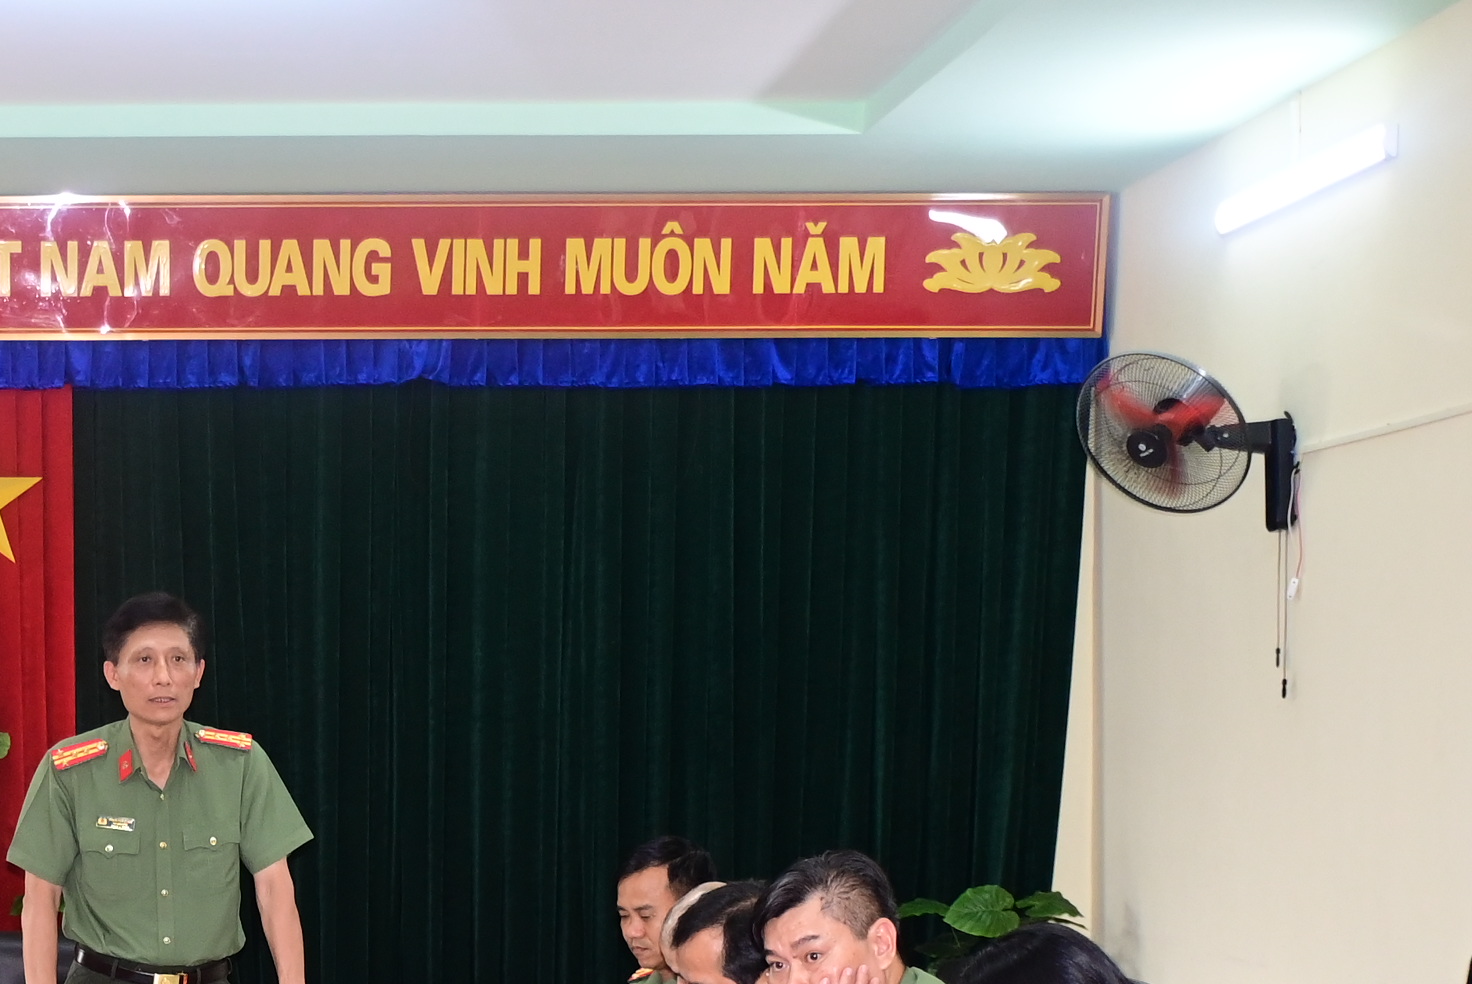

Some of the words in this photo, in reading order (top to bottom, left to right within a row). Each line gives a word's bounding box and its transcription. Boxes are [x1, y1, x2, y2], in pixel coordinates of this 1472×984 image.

[39, 239, 171, 298] NAM
[192, 236, 392, 298] QUANG
[411, 236, 541, 297] VINH
[562, 221, 732, 296] MUÔN
[752, 221, 886, 295] NĂM
